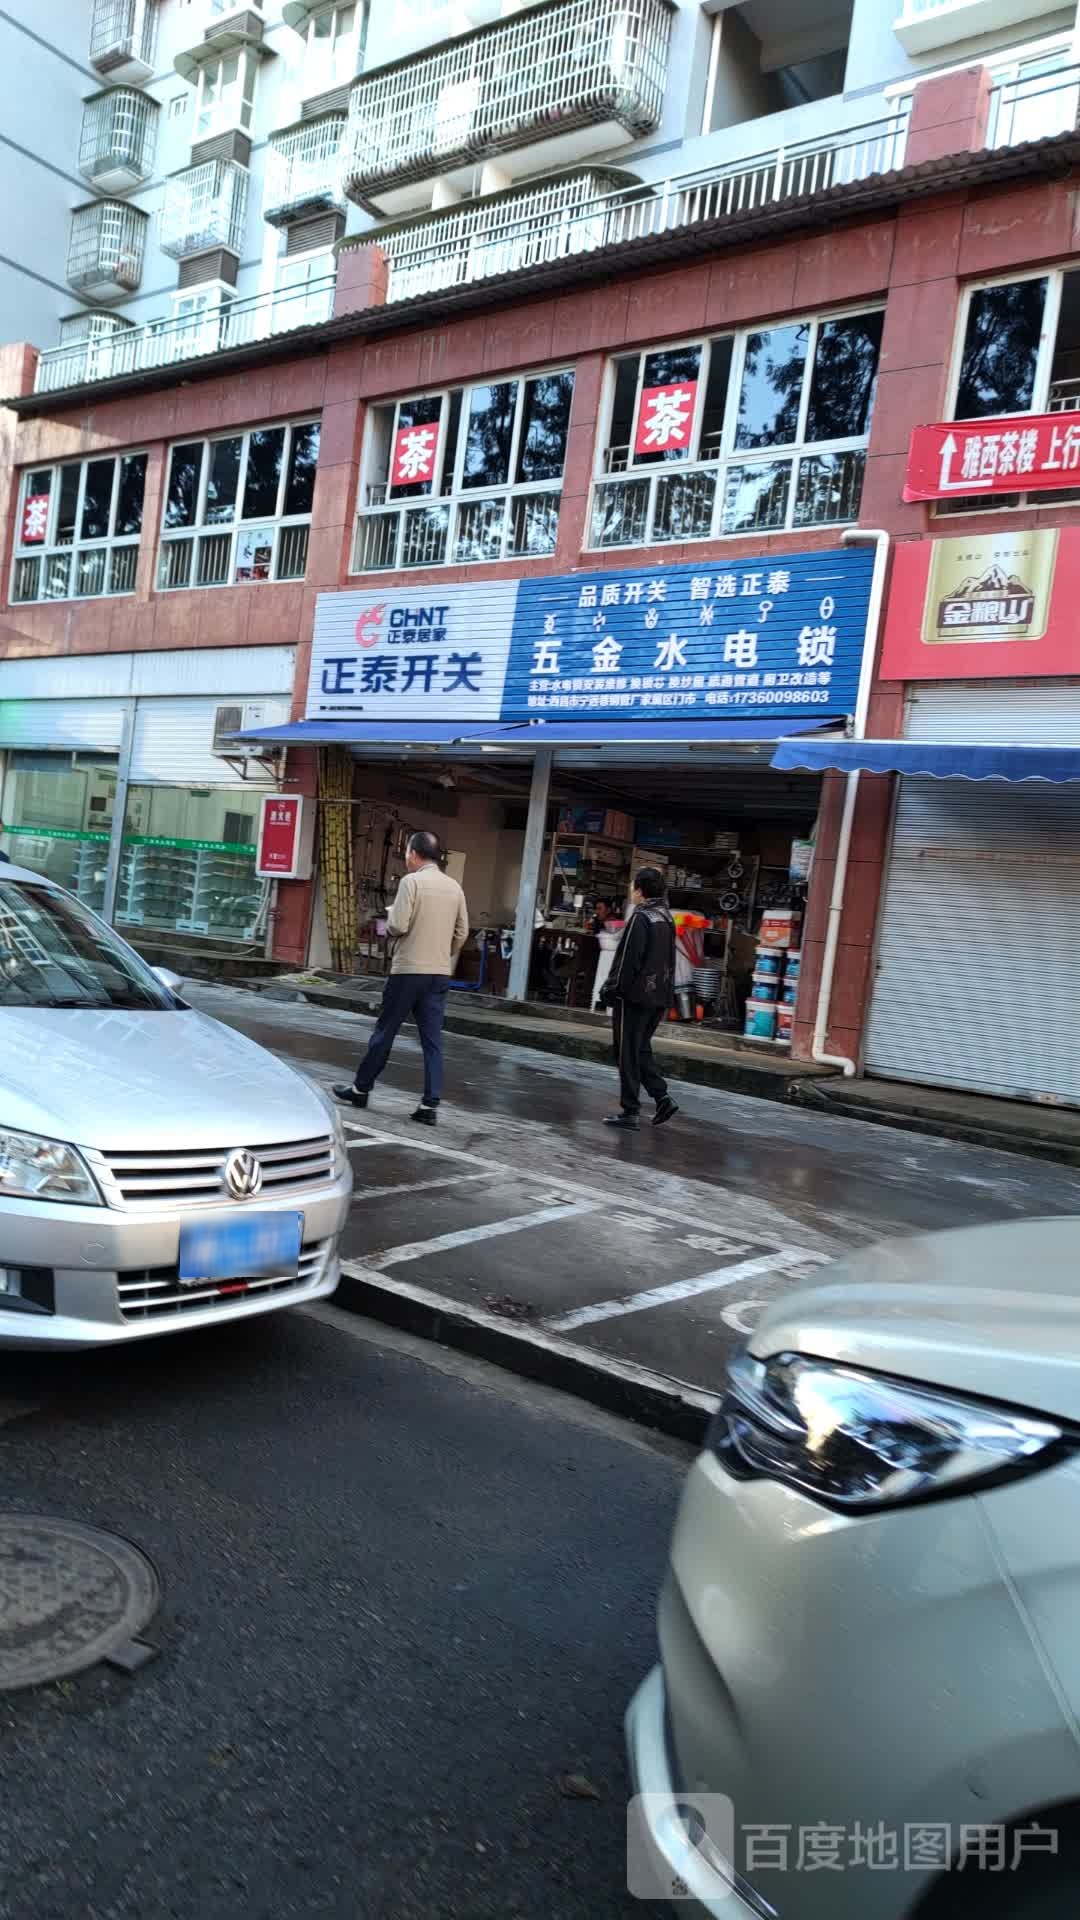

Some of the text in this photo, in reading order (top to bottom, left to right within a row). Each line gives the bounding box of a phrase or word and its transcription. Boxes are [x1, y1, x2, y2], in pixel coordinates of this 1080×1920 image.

[642, 386, 692, 447] 茶
[397, 427, 435, 479] 茶
[961, 427, 1039, 479] 雅西茶楼
[25, 499, 48, 538] 茶
[578, 571, 791, 608] 品质开关 智选正泰
[943, 600, 1030, 625] 金粮山
[387, 627, 448, 645] 正泰居家
[321, 651, 484, 695] 正泰开关
